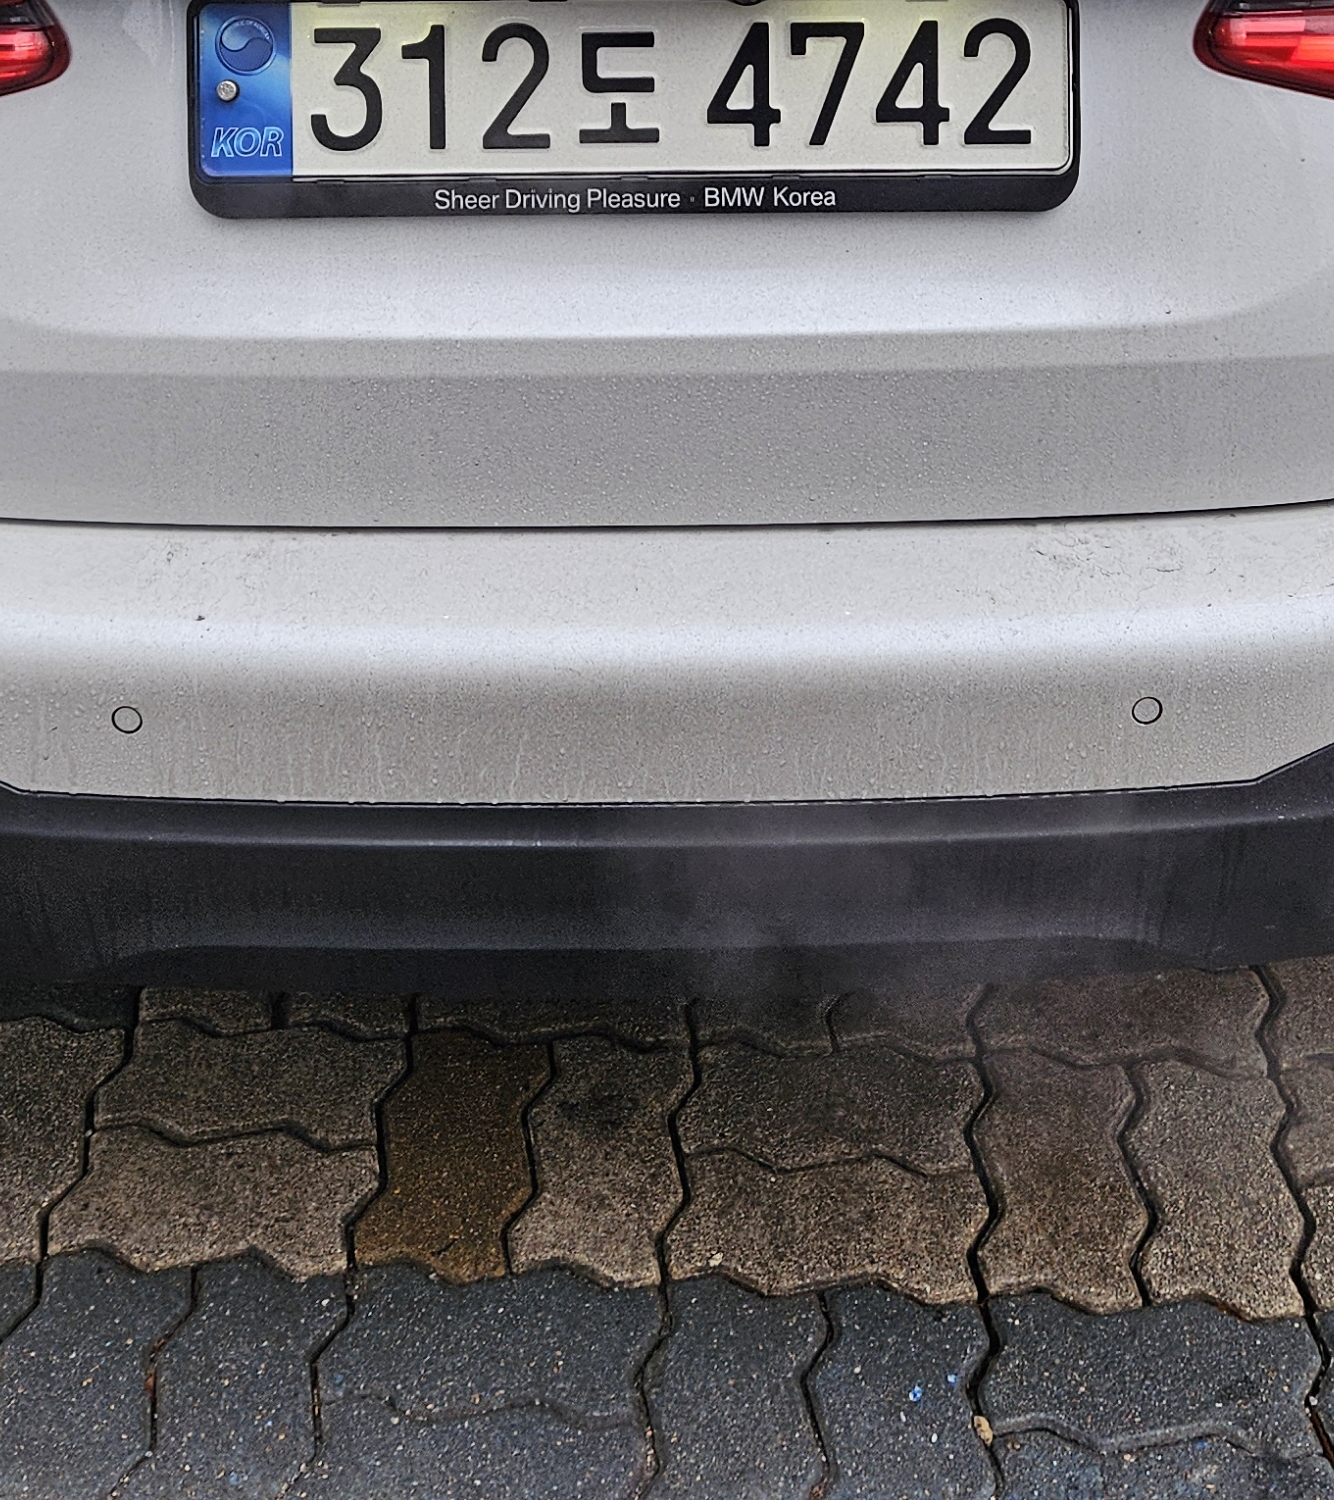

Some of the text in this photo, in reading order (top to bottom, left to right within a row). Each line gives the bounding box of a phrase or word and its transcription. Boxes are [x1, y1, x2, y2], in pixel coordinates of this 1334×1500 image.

[309, 19, 1034, 152] 312도 4742
[210, 126, 285, 158] KOR
[434, 185, 837, 213] Sheer Driving Pleasure BMW Korea
